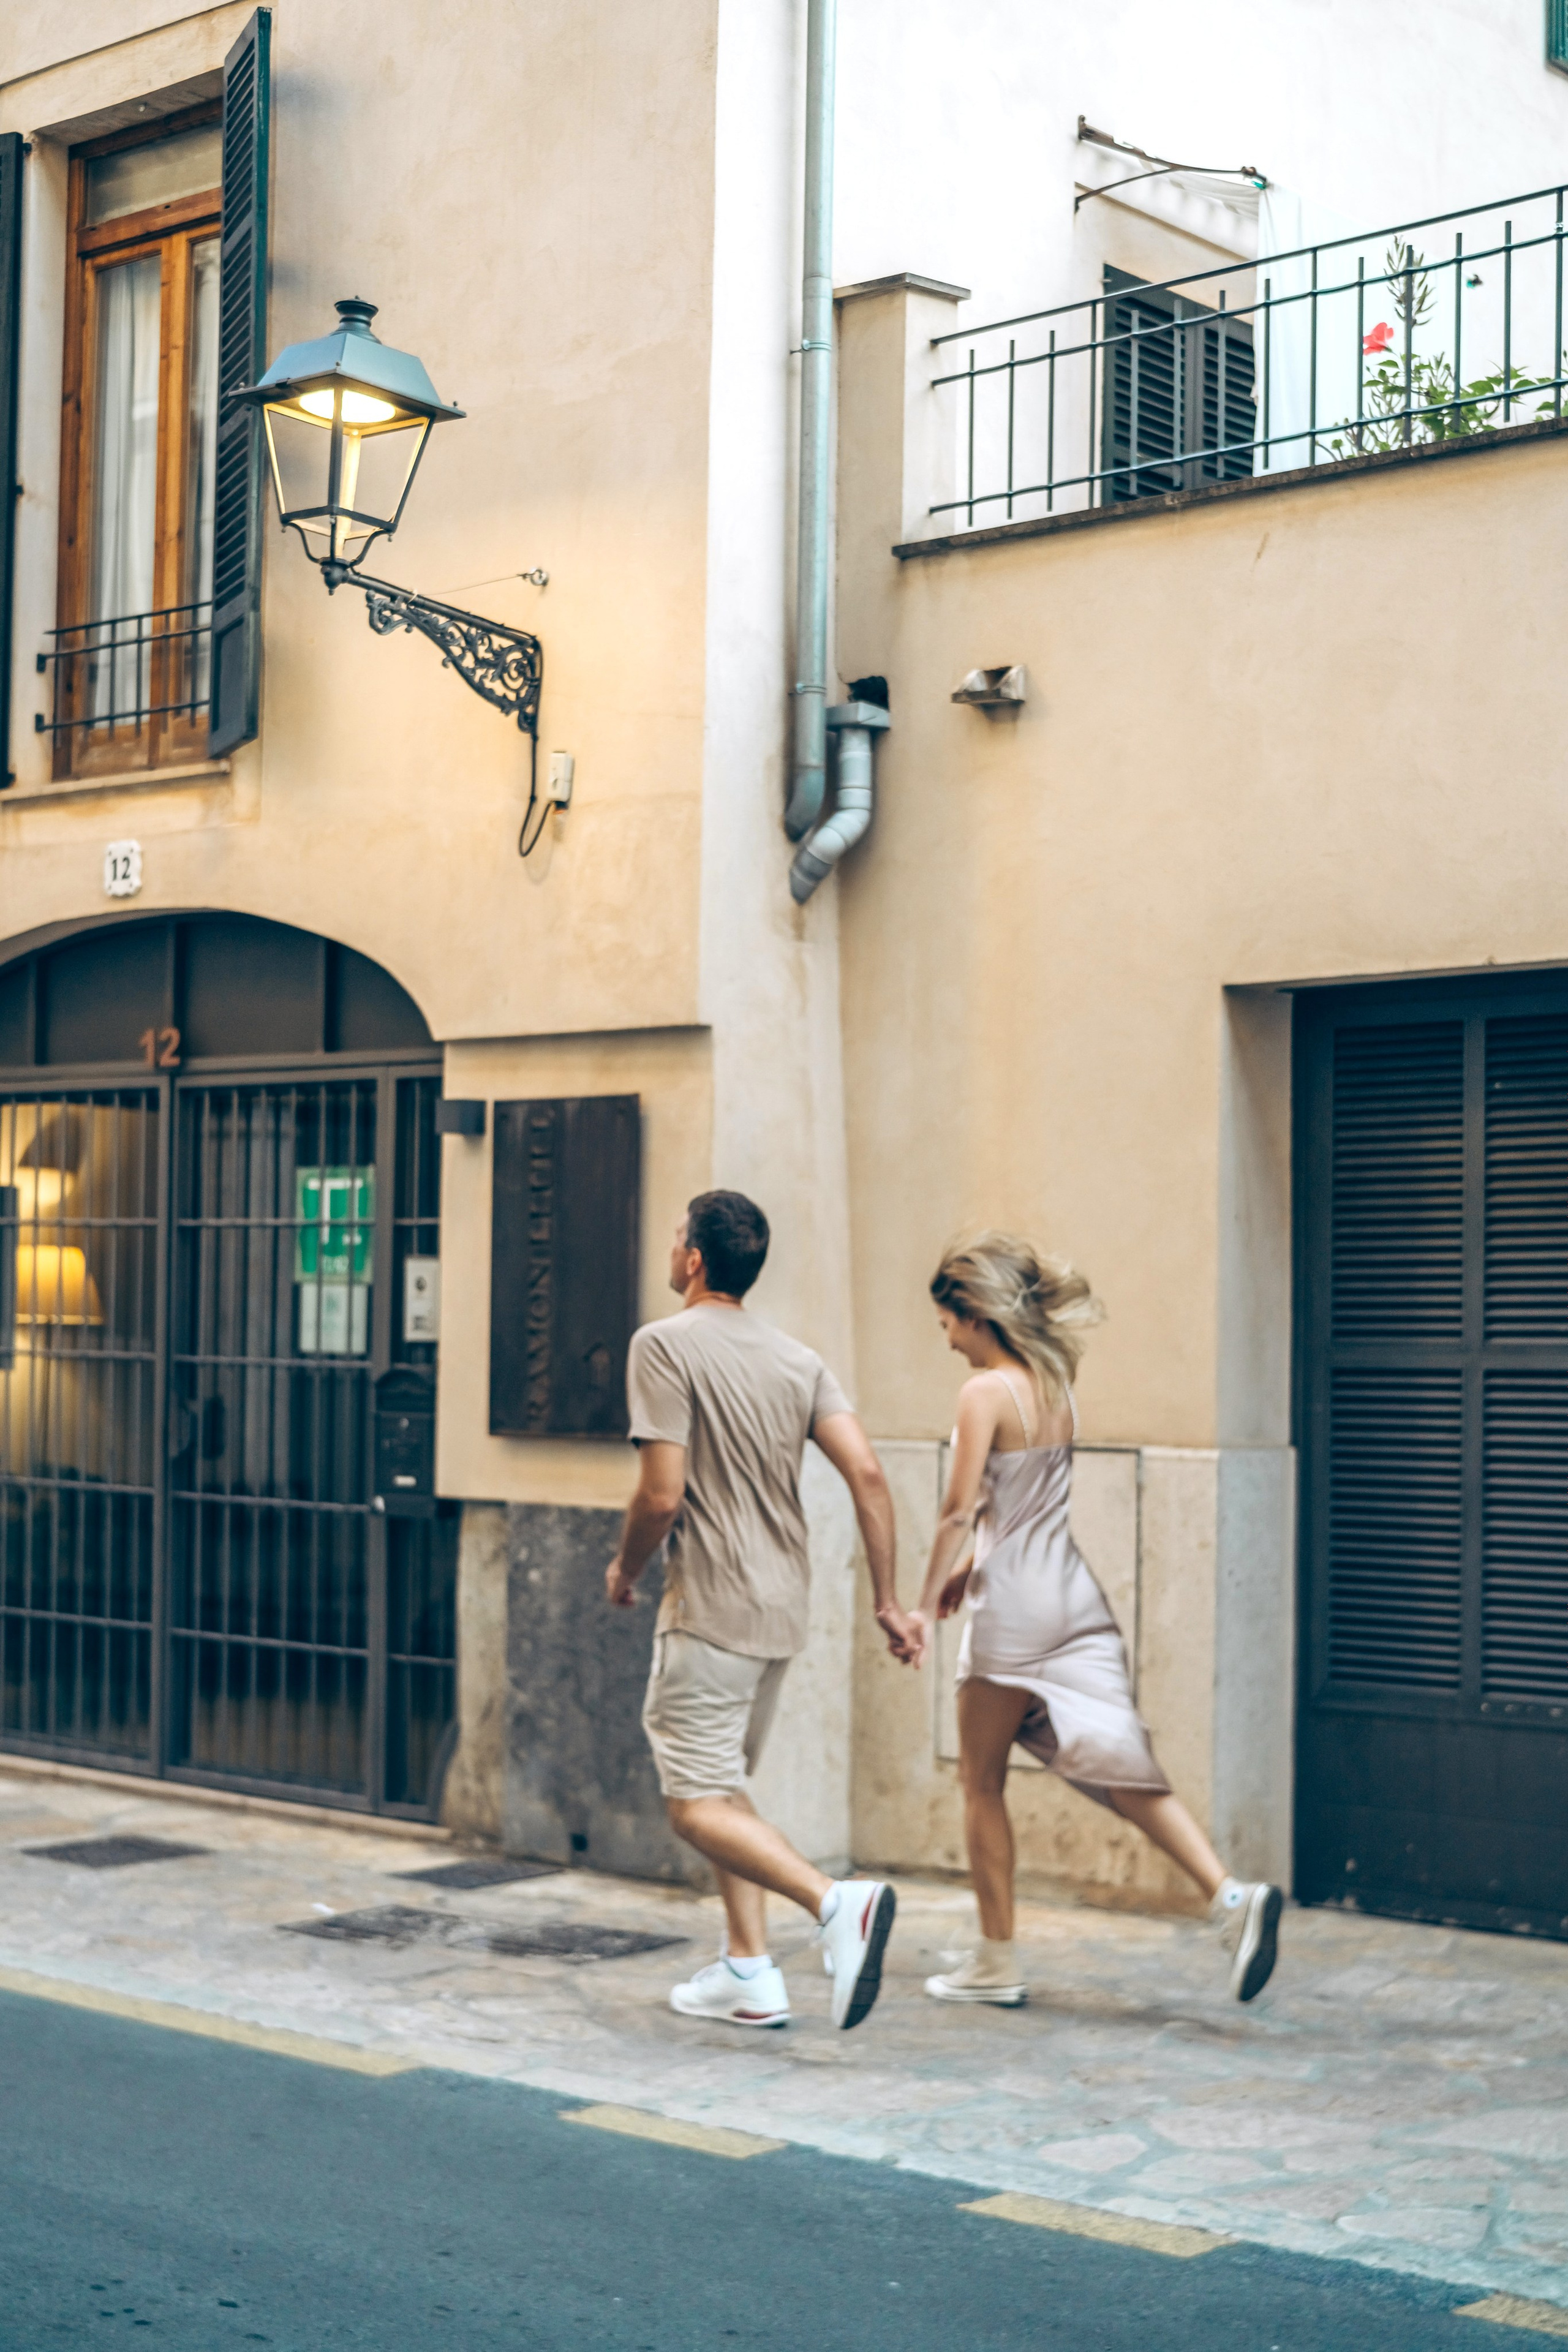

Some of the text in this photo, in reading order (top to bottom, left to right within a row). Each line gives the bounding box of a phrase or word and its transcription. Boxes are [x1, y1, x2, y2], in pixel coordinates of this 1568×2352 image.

[111, 856, 131, 881] 12
[138, 1027, 181, 1069] 12
[526, 1256, 551, 1422] RAMON
